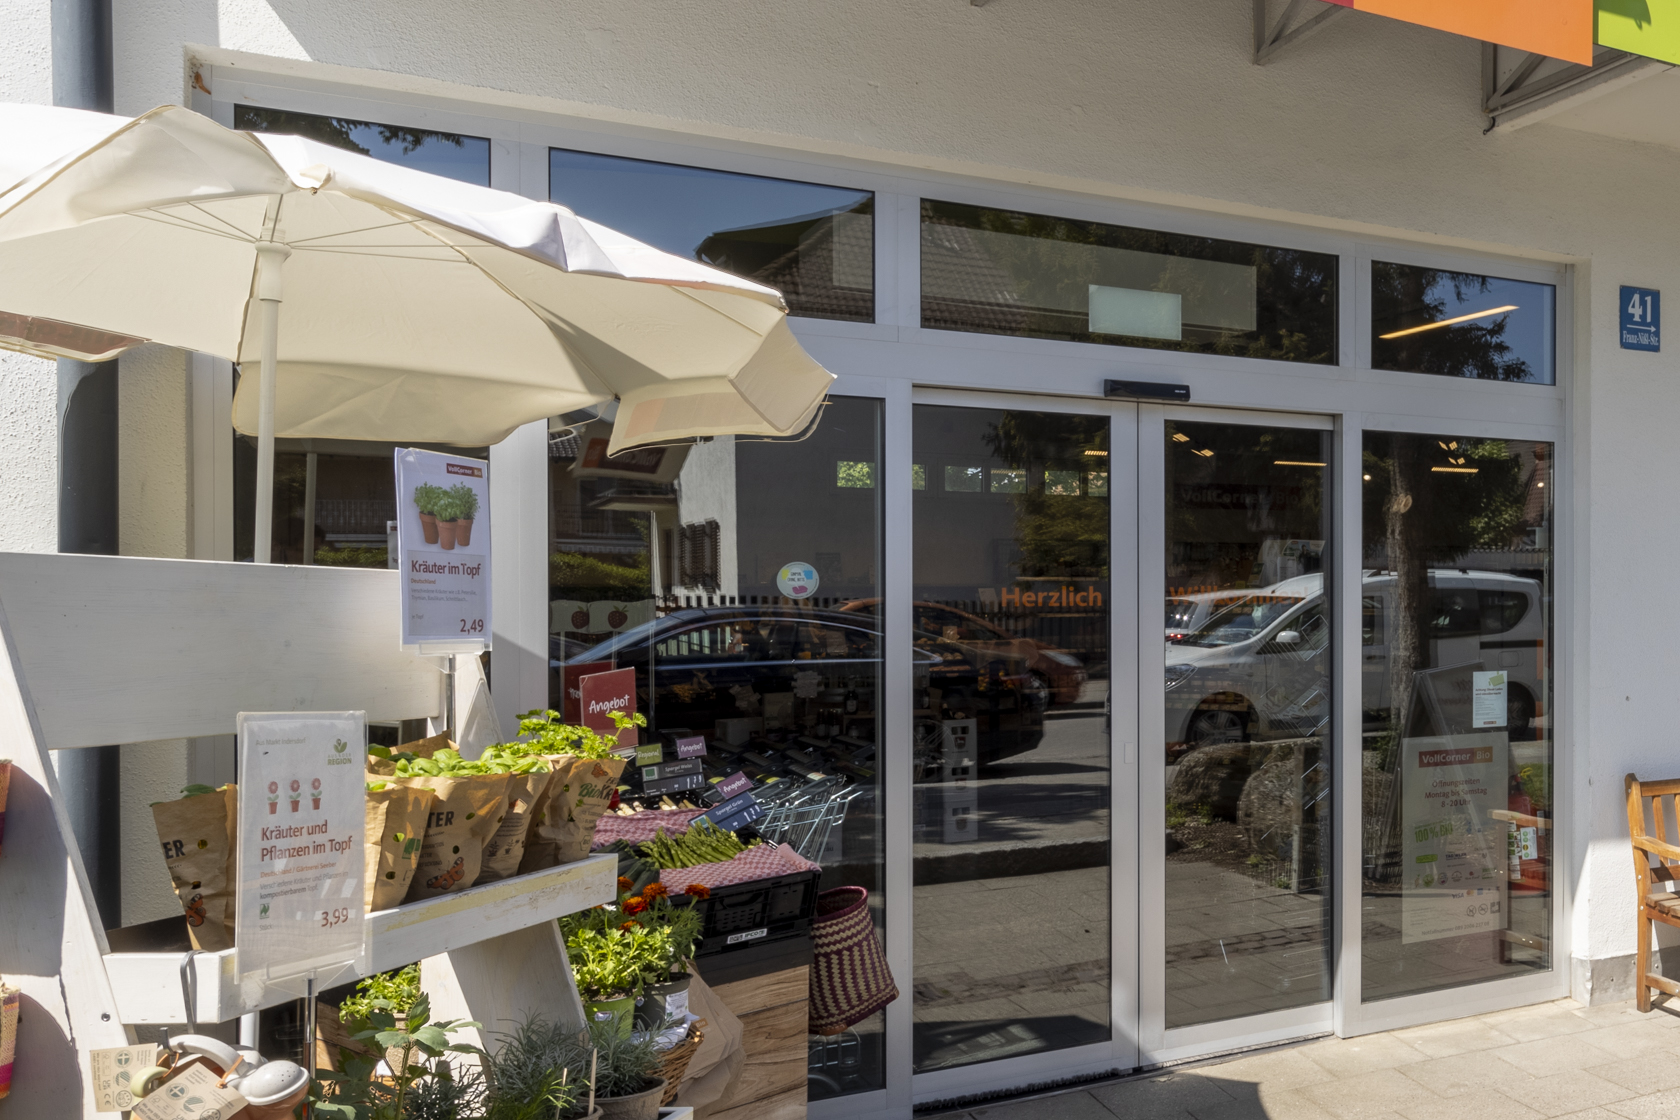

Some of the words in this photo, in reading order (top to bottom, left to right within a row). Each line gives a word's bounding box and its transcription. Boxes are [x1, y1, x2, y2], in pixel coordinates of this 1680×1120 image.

[1628, 293, 1652, 323] 41
[447, 465, 473, 475] VollCorner
[411, 560, 447, 575] Kräuter
[448, 562, 460, 575] im
[461, 563, 481, 579] Topf
[1001, 586, 1102, 608] Herzlich
[460, 619, 484, 635] 2,49
[588, 694, 630, 714] Angebot
[637, 748, 660, 758] Regional
[680, 742, 703, 753] Angebot
[327, 758, 352, 766] REGION
[1422, 752, 1471, 764] VollCorner
[1476, 751, 1490, 760] Bio
[665, 764, 680, 772] Spargel
[723, 777, 747, 793] Angebot
[1432, 777, 1480, 788] Öffnungszeiten
[1424, 791, 1450, 799] Montag
[1461, 787, 1488, 795] Samstag
[1450, 799, 1458, 807] 20
[1459, 798, 1471, 806] Uhr
[715, 804, 732, 816] Spargel
[261, 824, 304, 841] Kräuter
[307, 819, 328, 835] und
[261, 844, 310, 862] Pflanzen
[313, 841, 326, 855] im
[328, 835, 353, 855] Topf
[260, 868, 292, 878] Deutscand
[321, 907, 349, 929] 3,99
